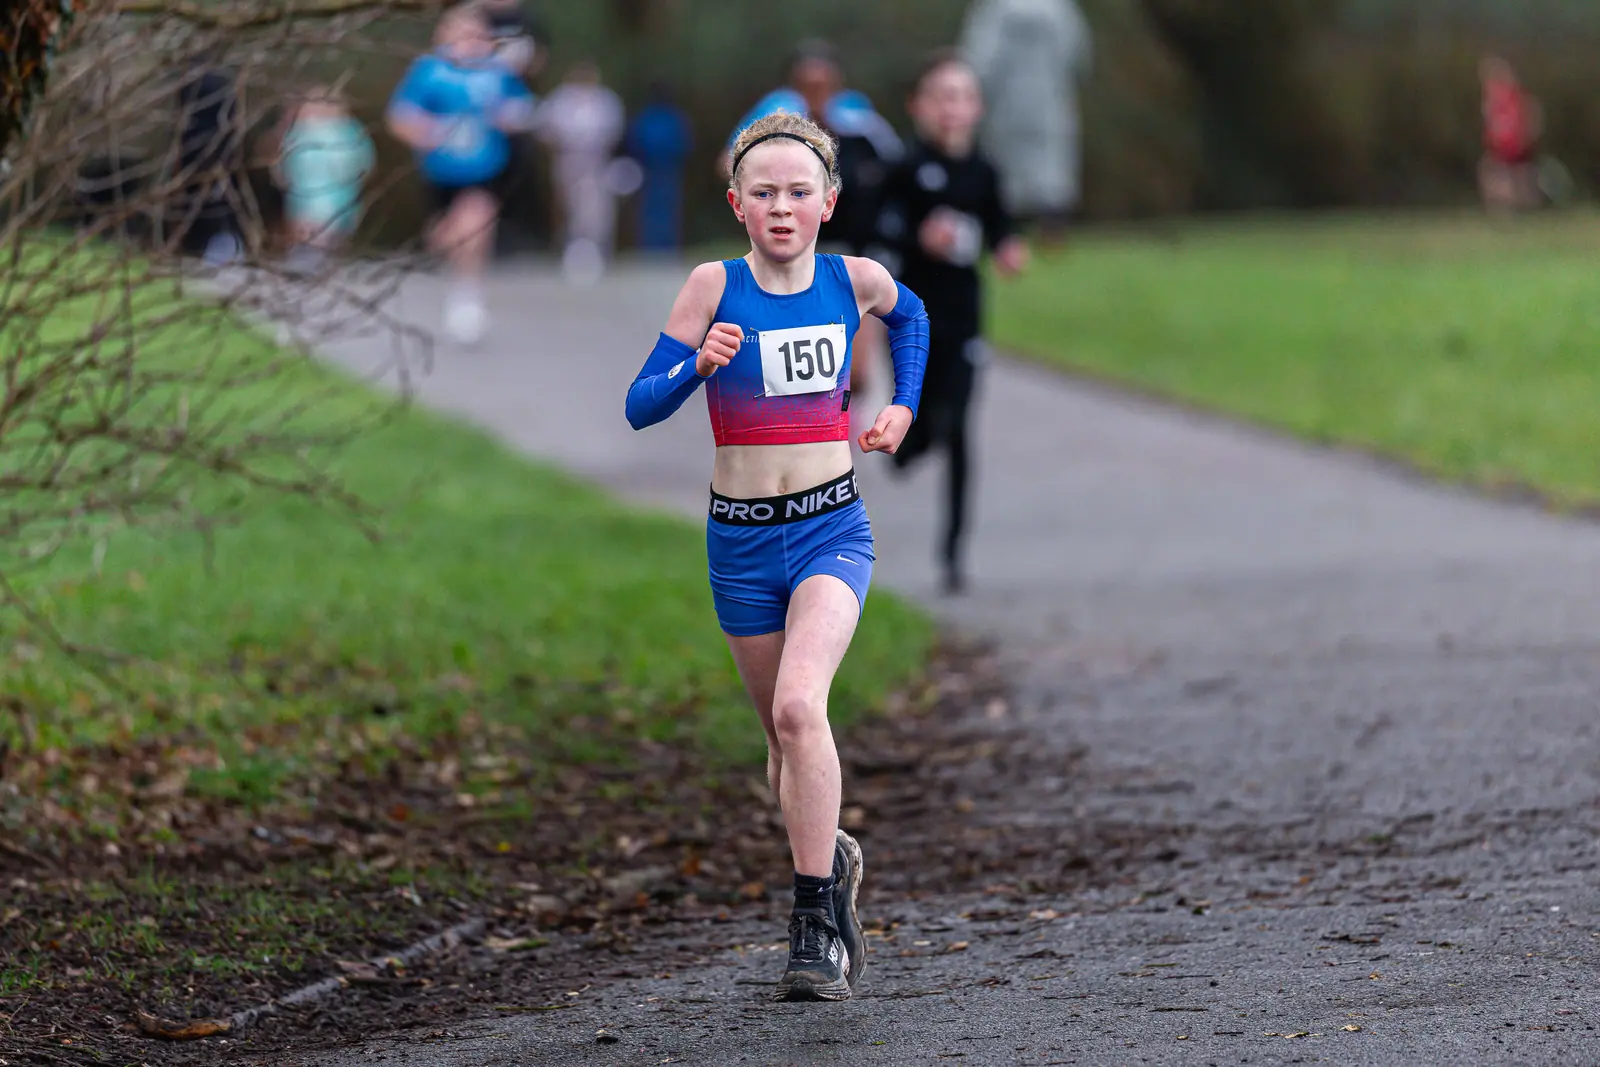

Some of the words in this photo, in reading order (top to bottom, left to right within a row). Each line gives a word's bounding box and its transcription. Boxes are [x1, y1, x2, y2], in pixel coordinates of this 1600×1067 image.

[778, 337, 836, 382] 150
[712, 499, 774, 521] PRO
[785, 479, 852, 518] NIKE
